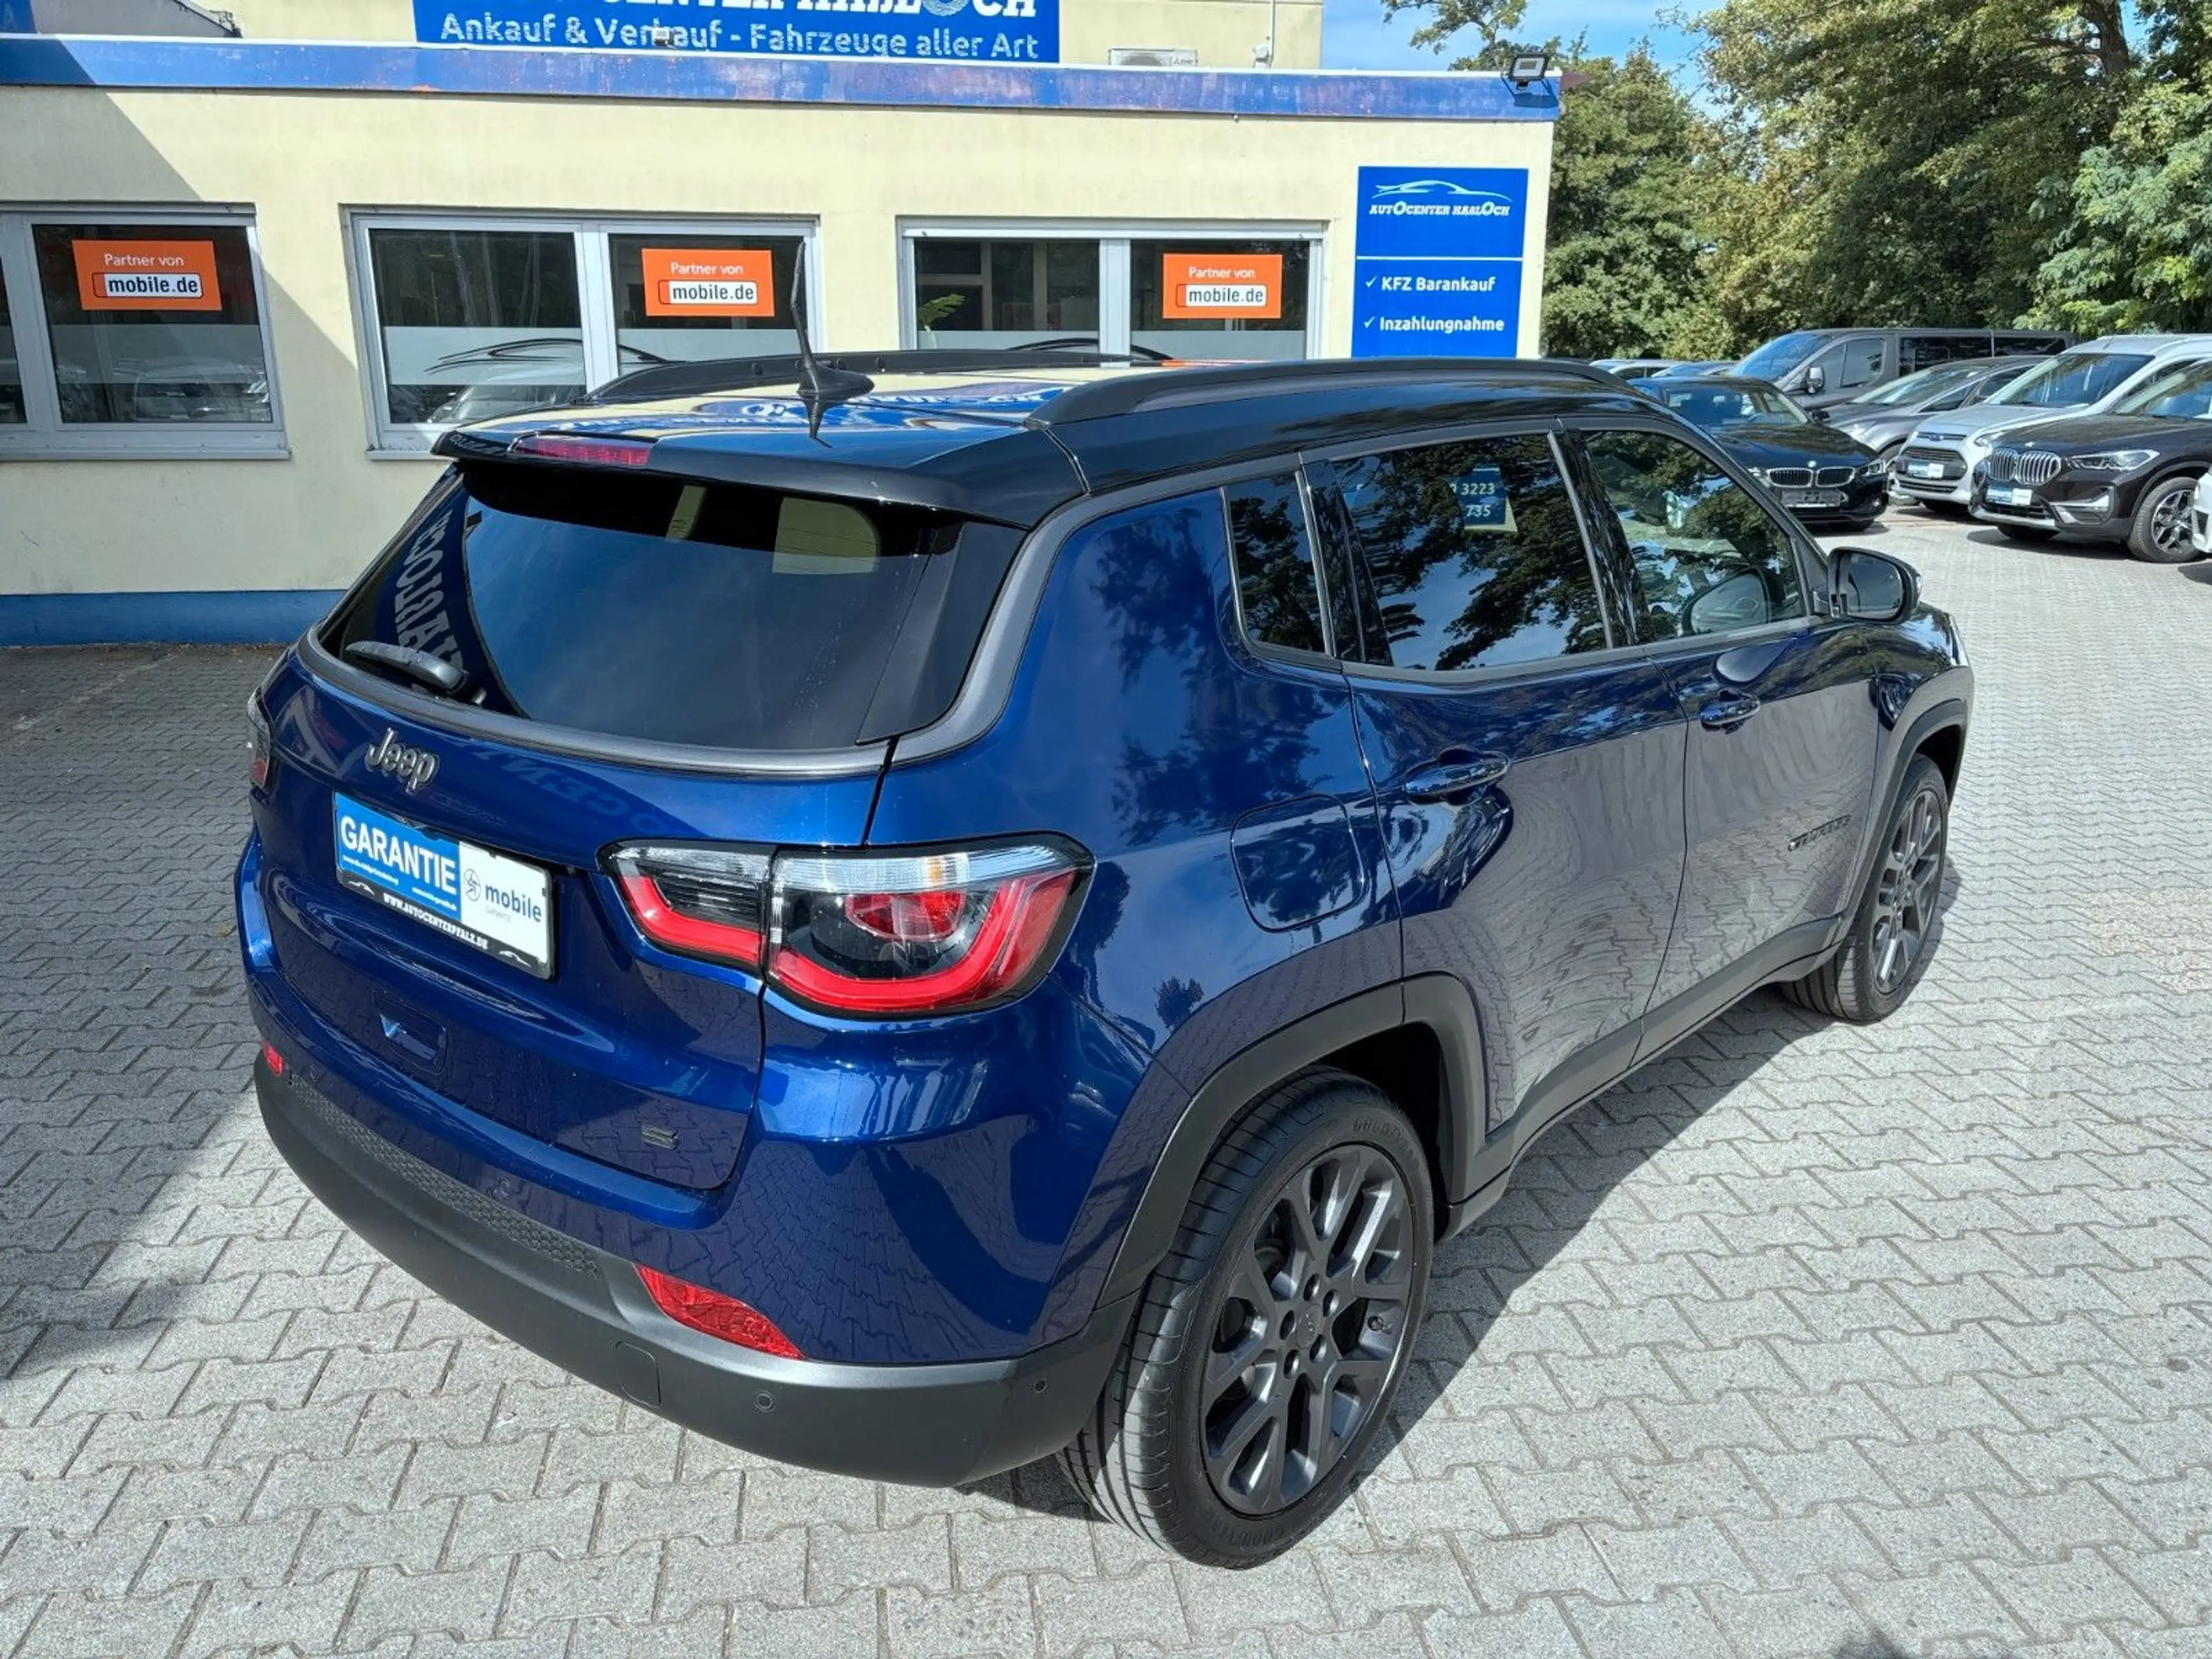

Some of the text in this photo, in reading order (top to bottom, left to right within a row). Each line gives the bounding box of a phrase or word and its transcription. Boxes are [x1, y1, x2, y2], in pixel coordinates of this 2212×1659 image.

[440, 12, 556, 43] Ankauf
[565, 17, 588, 44] &
[749, 24, 907, 57] Fahrzeuge
[916, 28, 983, 56] aller
[991, 32, 1039, 58] Art
[104, 253, 184, 266] Partner von
[671, 262, 743, 275] Partner von
[1188, 266, 1255, 278] Partner von
[109, 276, 198, 293] mobile.de
[1381, 276, 1496, 291] KFZ Barankauf
[673, 285, 754, 300] mobile.de
[1189, 288, 1263, 302] mobile.de
[1380, 316, 1505, 334] Inzahlungnahme
[1460, 482, 1495, 496] 3223
[364, 727, 441, 795] Jeep
[340, 815, 457, 896] GARANTIE
[485, 884, 542, 923] mobile
